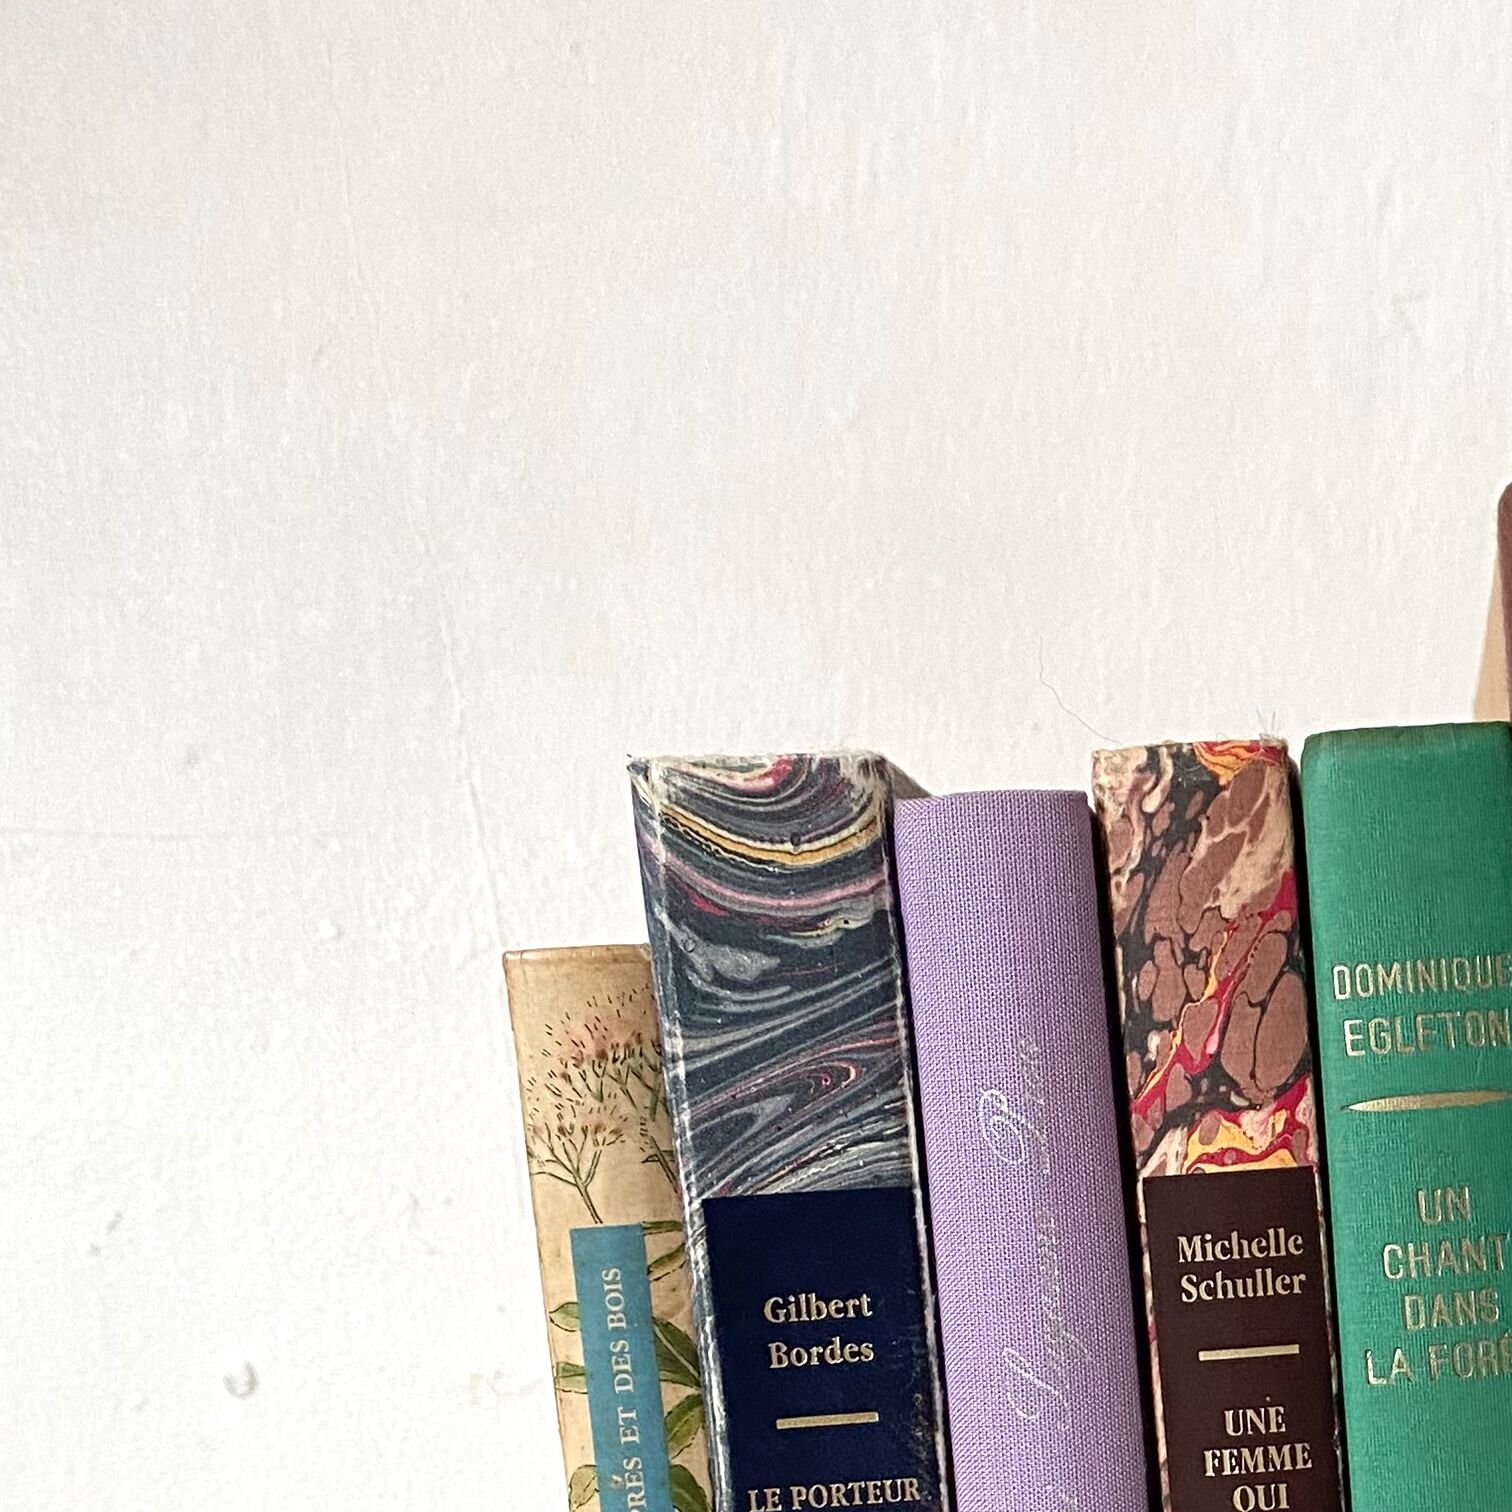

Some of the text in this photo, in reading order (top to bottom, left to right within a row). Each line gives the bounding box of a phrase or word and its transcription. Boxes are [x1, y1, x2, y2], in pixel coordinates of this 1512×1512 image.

[1343, 1007, 1512, 1058] EGLETON
[1418, 1185, 1470, 1227] UN
[1177, 1226, 1304, 1264] Michelle
[1383, 1231, 1509, 1280] CHANT
[601, 1267, 627, 1330] BOIS
[1180, 1268, 1307, 1305] Schuller
[764, 1292, 873, 1324] Gilbert
[1404, 1286, 1500, 1331] DANS
[610, 1341, 634, 1394] DES
[769, 1336, 874, 1369] Bordes
[1365, 1347, 1413, 1386] LA
[621, 1406, 641, 1444] ET
[1223, 1406, 1287, 1437] UNE
[1203, 1443, 1312, 1477] FEMME
[791, 1478, 921, 1510] PORTEUR
